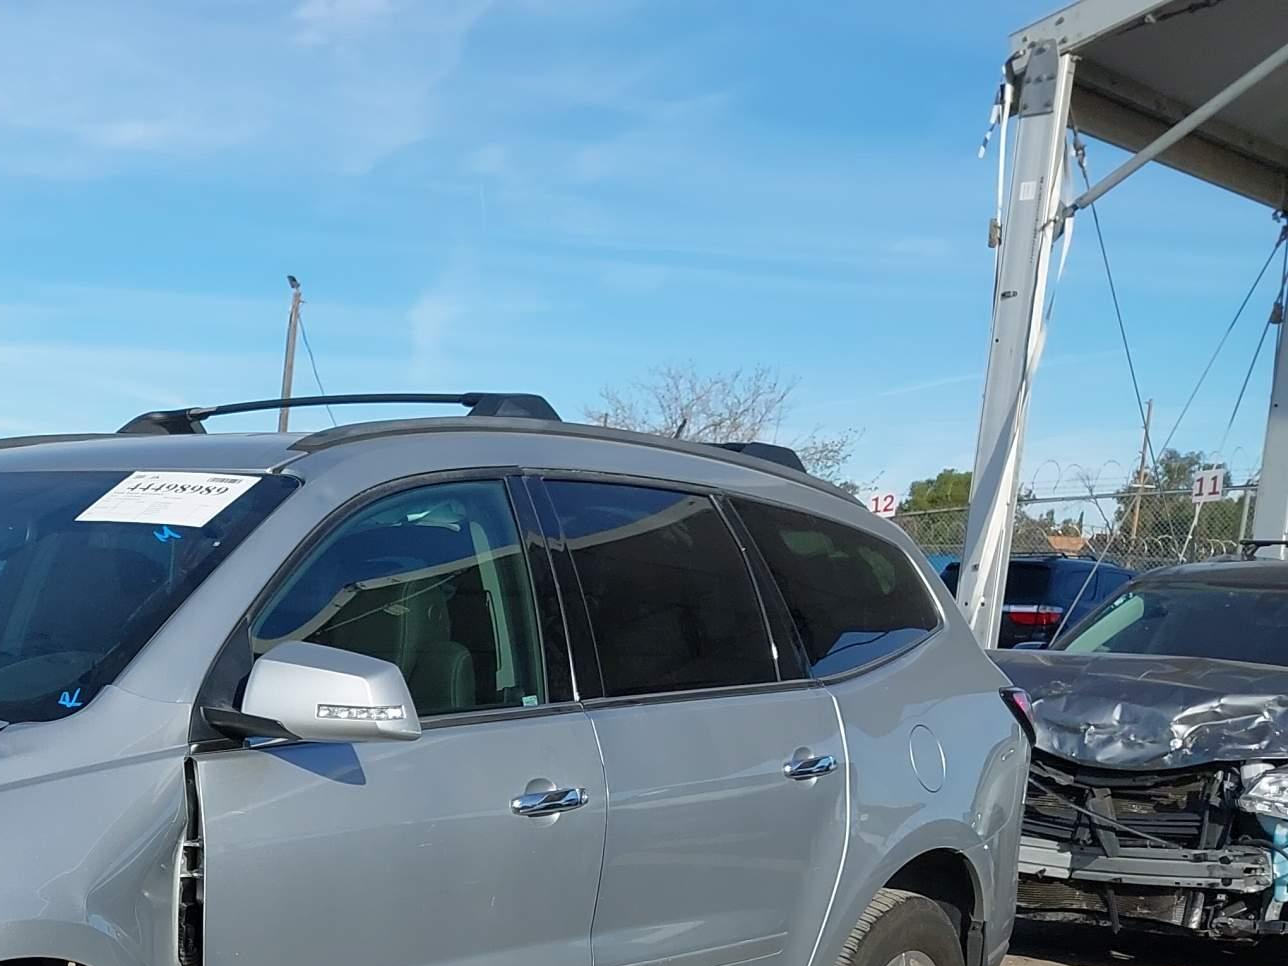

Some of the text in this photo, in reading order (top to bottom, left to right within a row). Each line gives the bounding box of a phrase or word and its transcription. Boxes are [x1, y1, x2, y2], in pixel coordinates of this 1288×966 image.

[126, 481, 231, 496] 44498989
[1194, 475, 1220, 497] 11
[871, 494, 895, 513] 12
